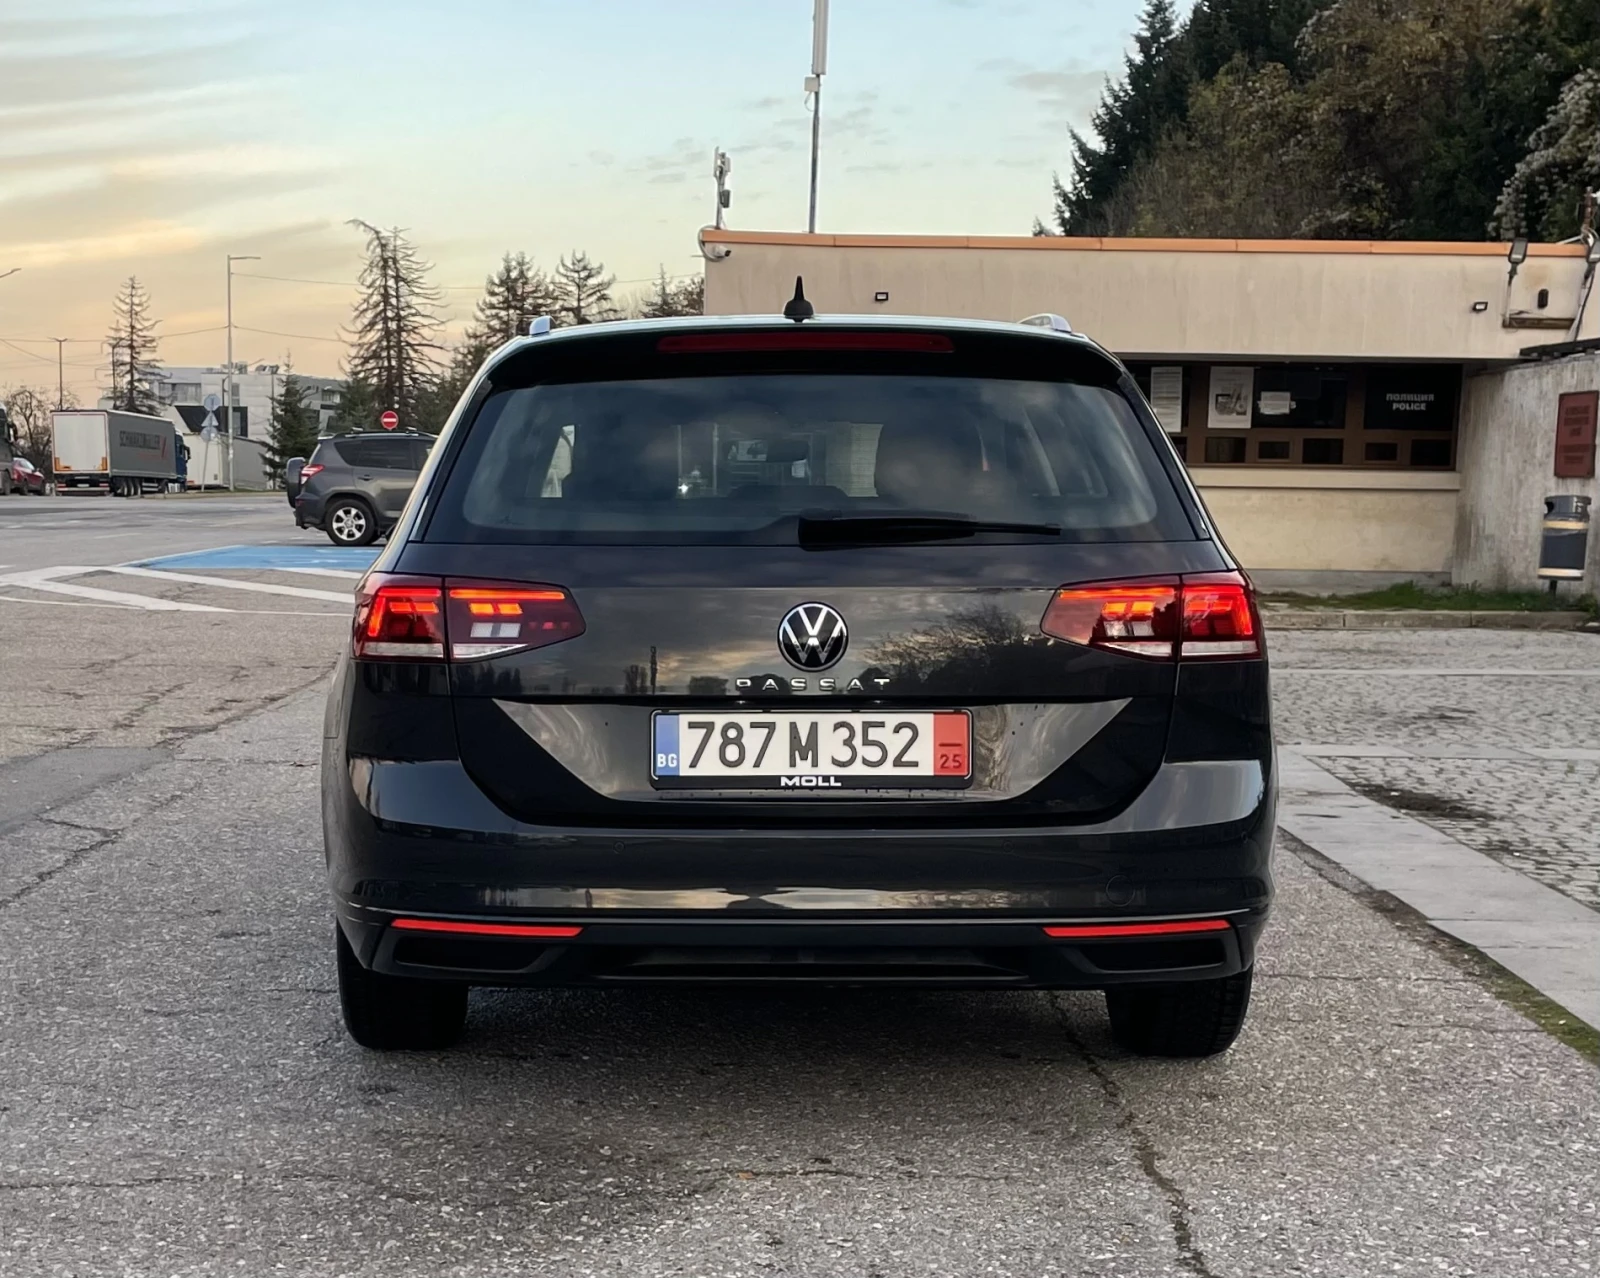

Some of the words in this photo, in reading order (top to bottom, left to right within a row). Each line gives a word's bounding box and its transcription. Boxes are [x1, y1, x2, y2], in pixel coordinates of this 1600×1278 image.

[1392, 402, 1427, 411] POLICE
[736, 678, 891, 691] PASSAT
[687, 721, 777, 769] 787
[788, 721, 819, 768] M
[830, 721, 920, 768] 352
[657, 753, 678, 768] BG
[939, 753, 963, 769] 25
[780, 776, 842, 787] MOLL
